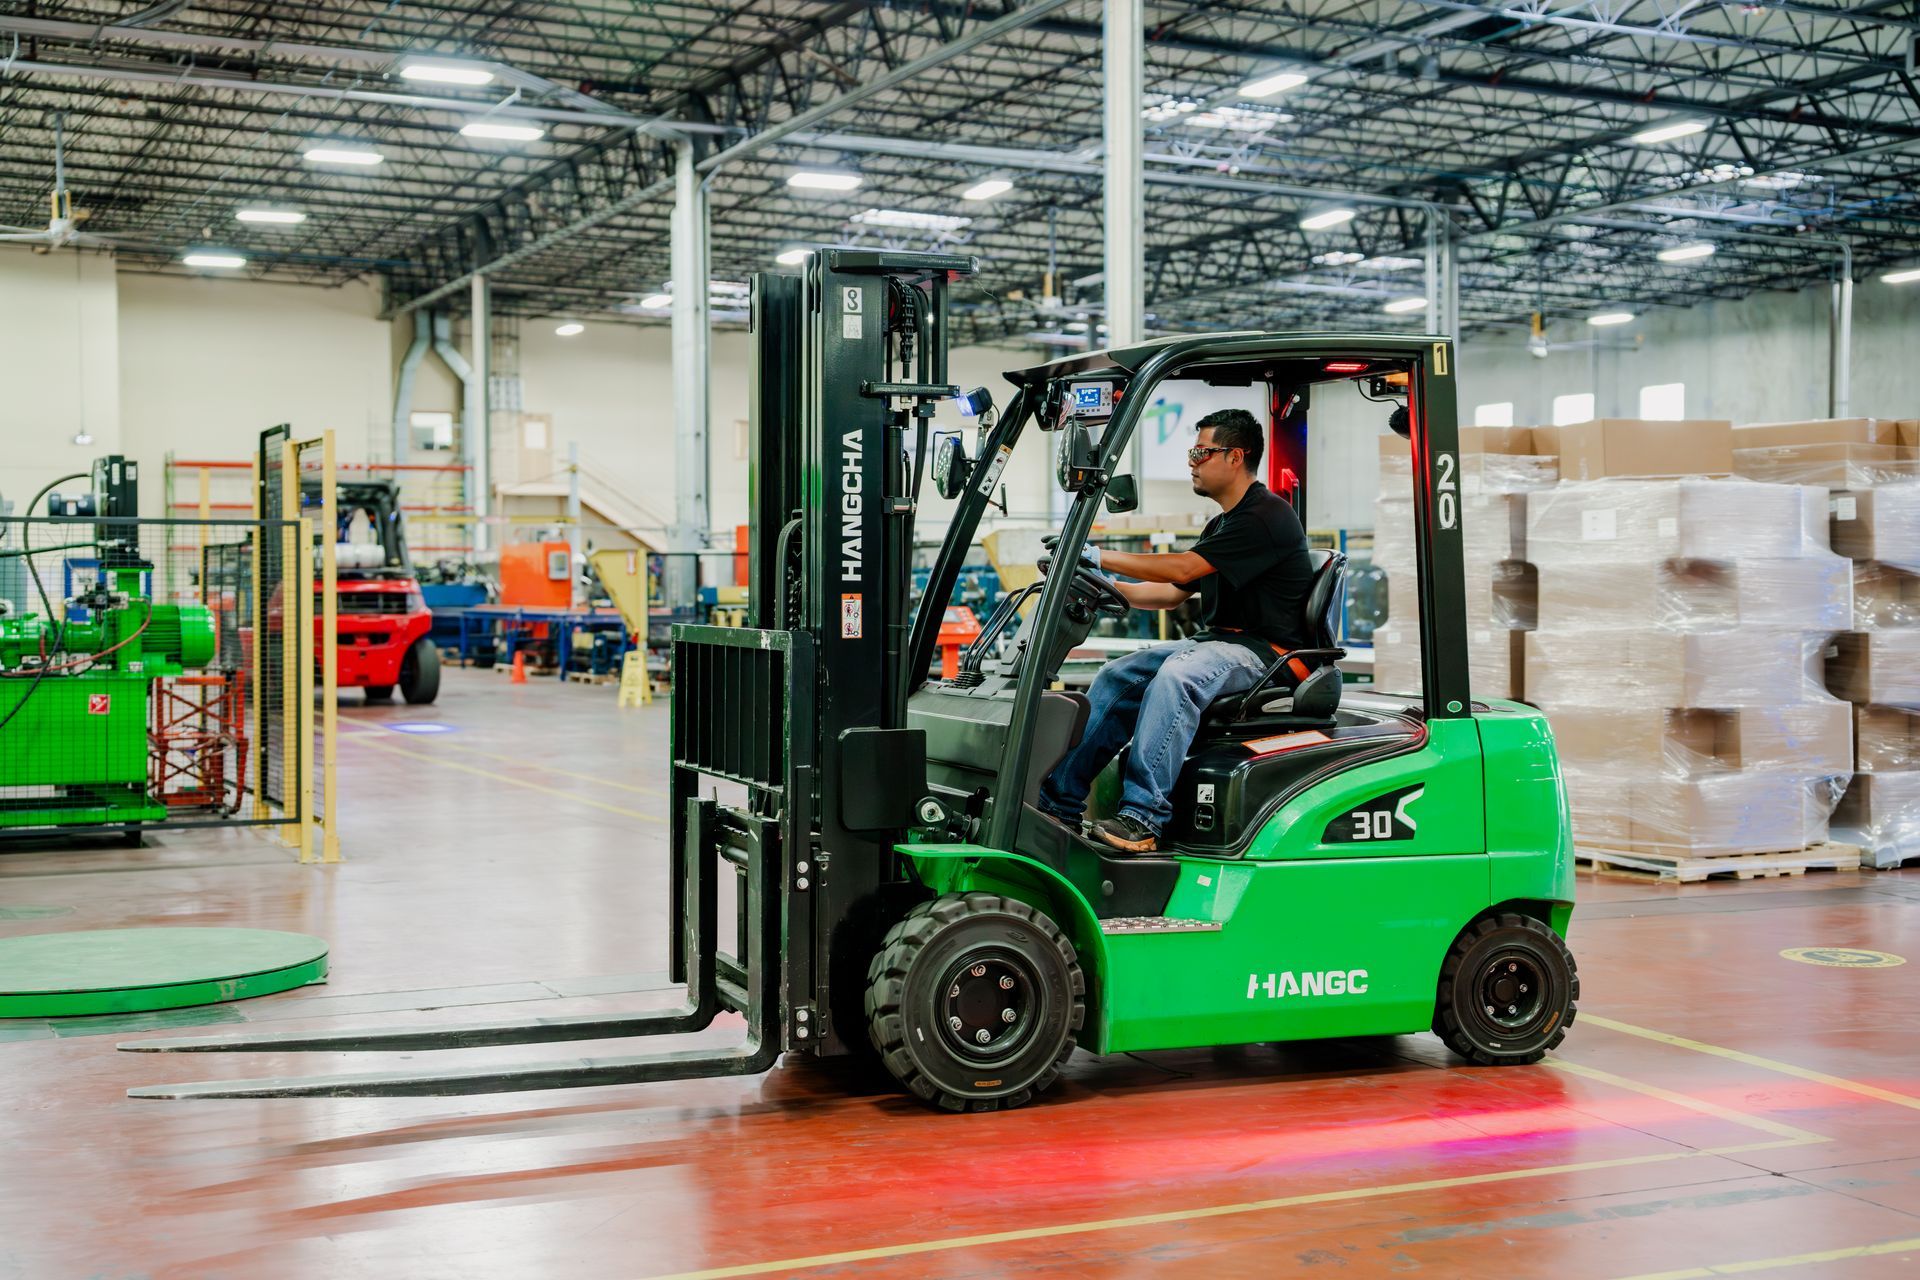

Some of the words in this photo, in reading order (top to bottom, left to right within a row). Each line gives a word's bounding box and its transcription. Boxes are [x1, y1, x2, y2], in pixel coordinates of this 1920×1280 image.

[1436, 345, 1446, 374] 1
[841, 428, 863, 582] HANGCHA
[1436, 453, 1456, 529] 20
[1351, 810, 1392, 840] 30
[1246, 969, 1369, 999] HANGC
